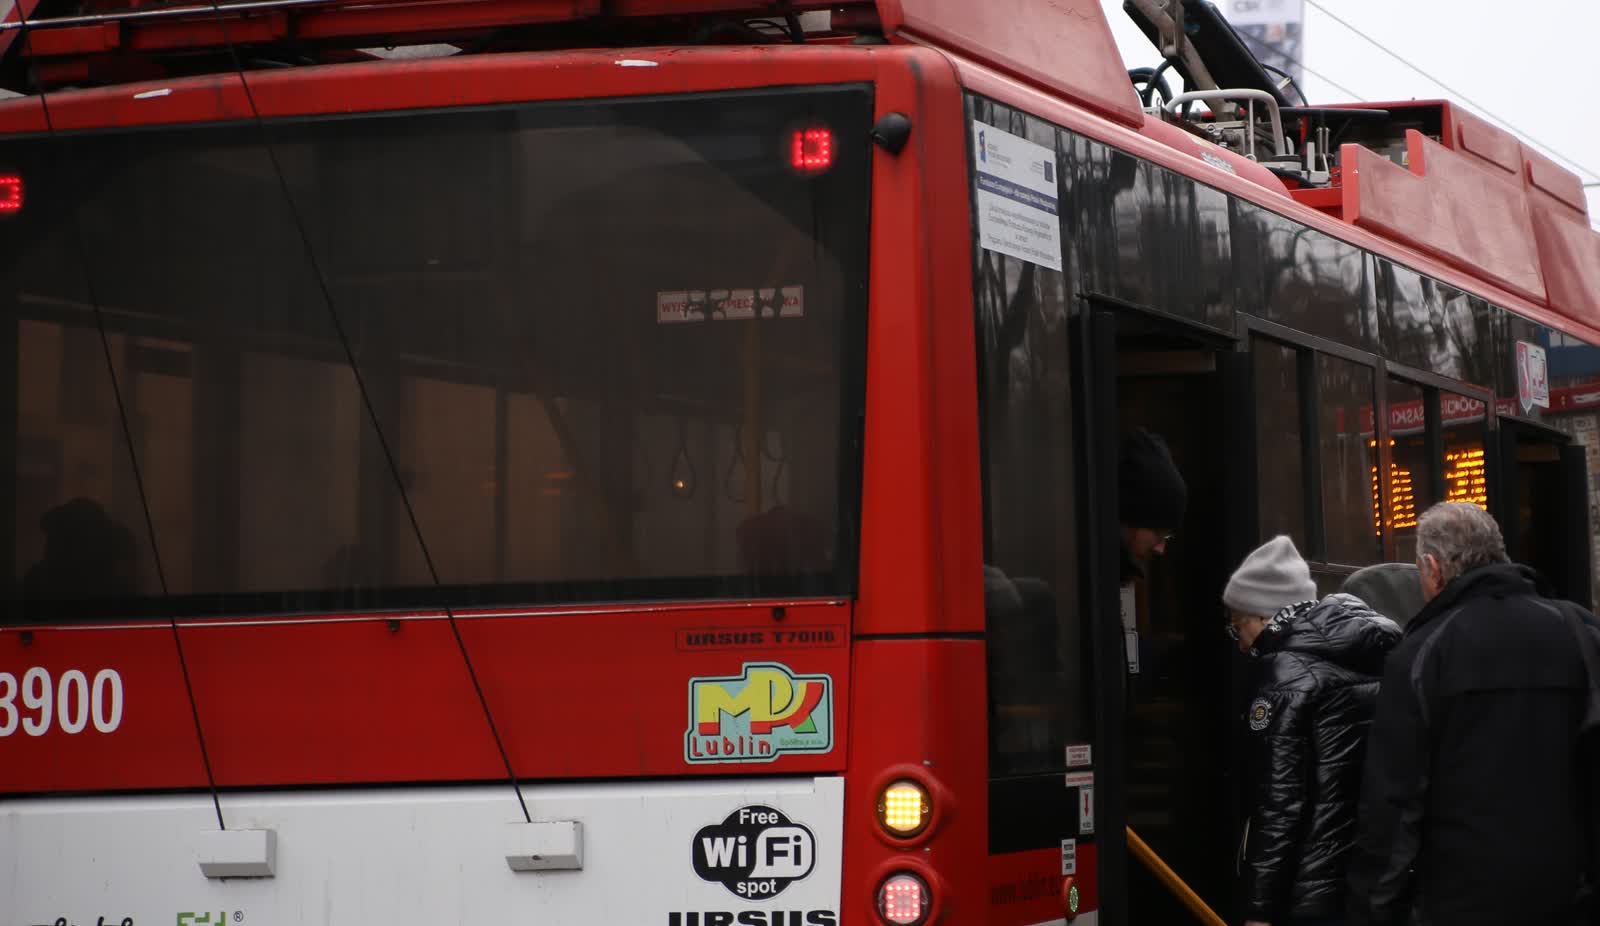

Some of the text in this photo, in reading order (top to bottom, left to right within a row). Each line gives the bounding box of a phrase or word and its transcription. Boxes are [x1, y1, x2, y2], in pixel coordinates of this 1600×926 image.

[686, 631, 764, 646] URSUS
[692, 735, 771, 757] Lublin
[739, 809, 779, 825] Free
[736, 879, 777, 897] spot
